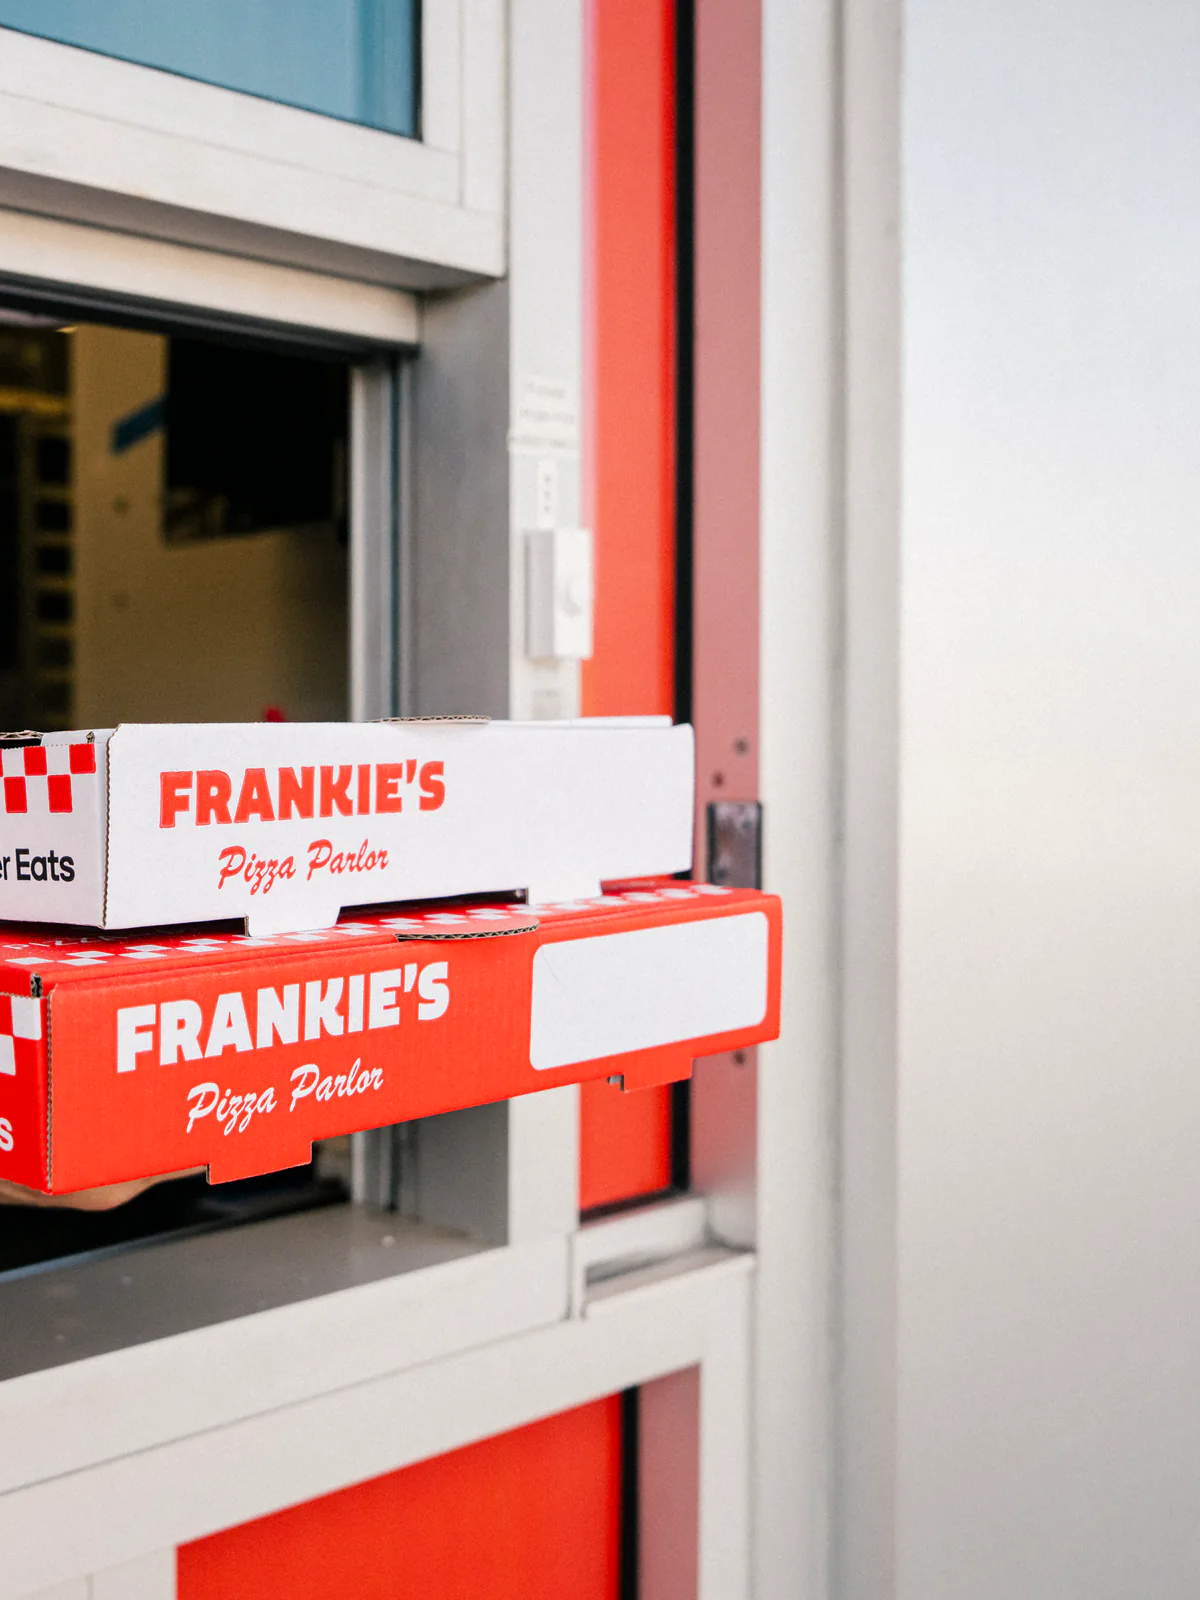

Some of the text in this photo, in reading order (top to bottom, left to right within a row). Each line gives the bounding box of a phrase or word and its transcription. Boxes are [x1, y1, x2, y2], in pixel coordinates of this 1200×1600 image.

[159, 758, 446, 829] FRANKIE'S
[15, 848, 76, 883] Eats
[217, 839, 390, 896] Pizza Parlor
[116, 960, 451, 1074] FRANKIE'S
[185, 1057, 385, 1137] Pizza Parlor
